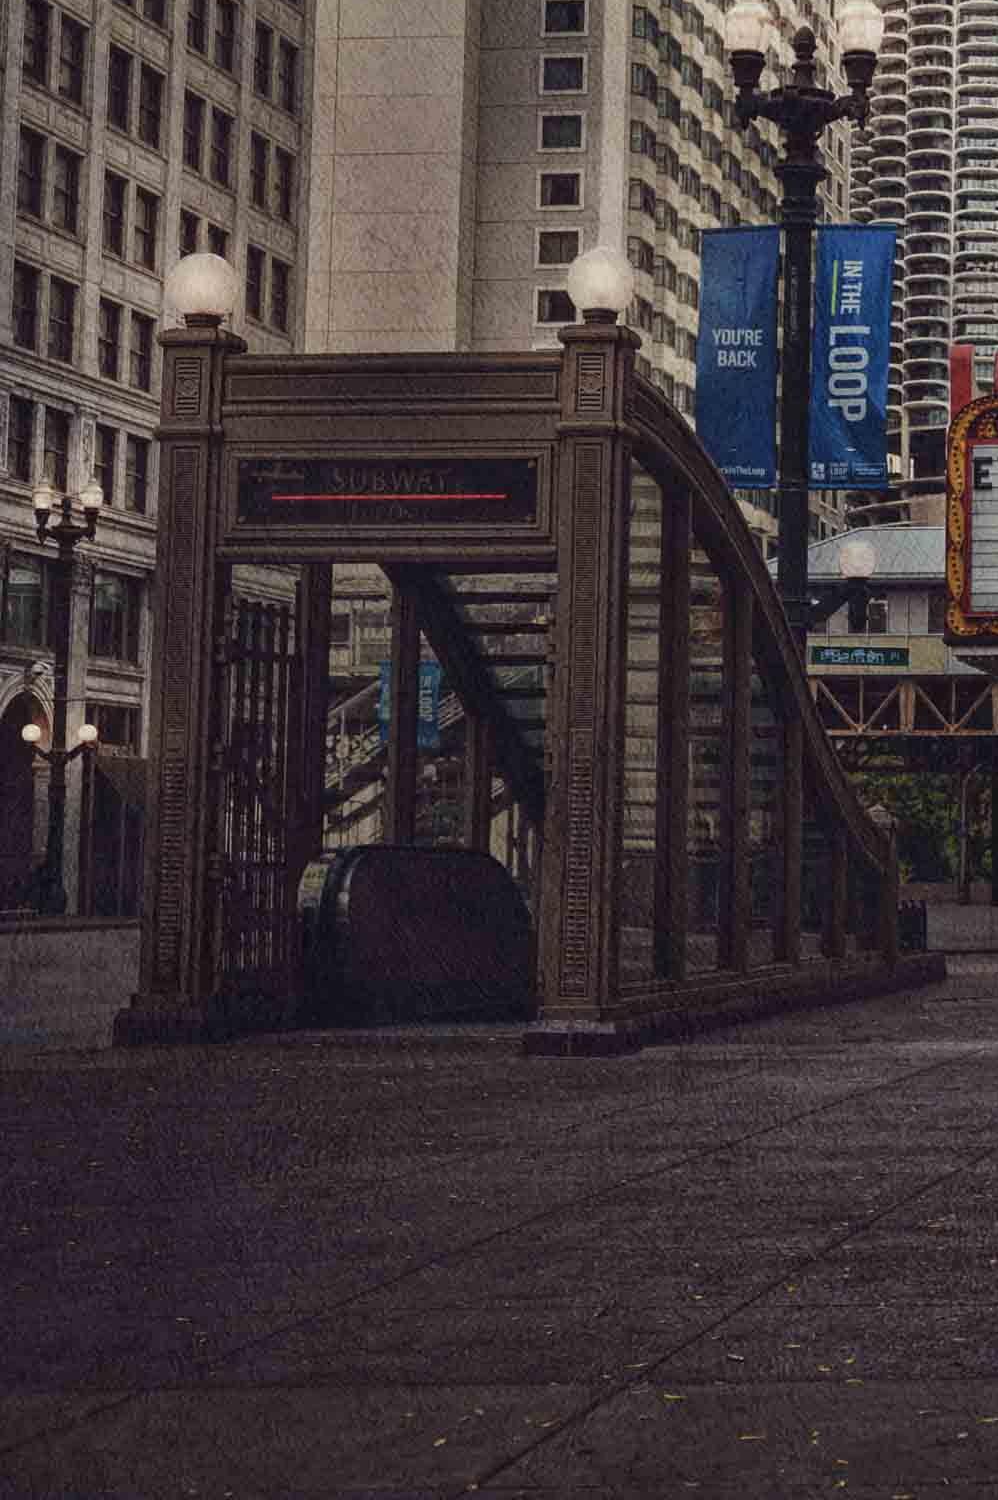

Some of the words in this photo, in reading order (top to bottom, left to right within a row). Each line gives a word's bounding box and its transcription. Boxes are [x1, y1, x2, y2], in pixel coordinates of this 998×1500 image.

[842, 260, 864, 277] IN
[840, 283, 862, 316] THE
[712, 327, 764, 346] YOU'RE
[717, 349, 757, 368] BACK
[828, 325, 871, 422] LOOP
